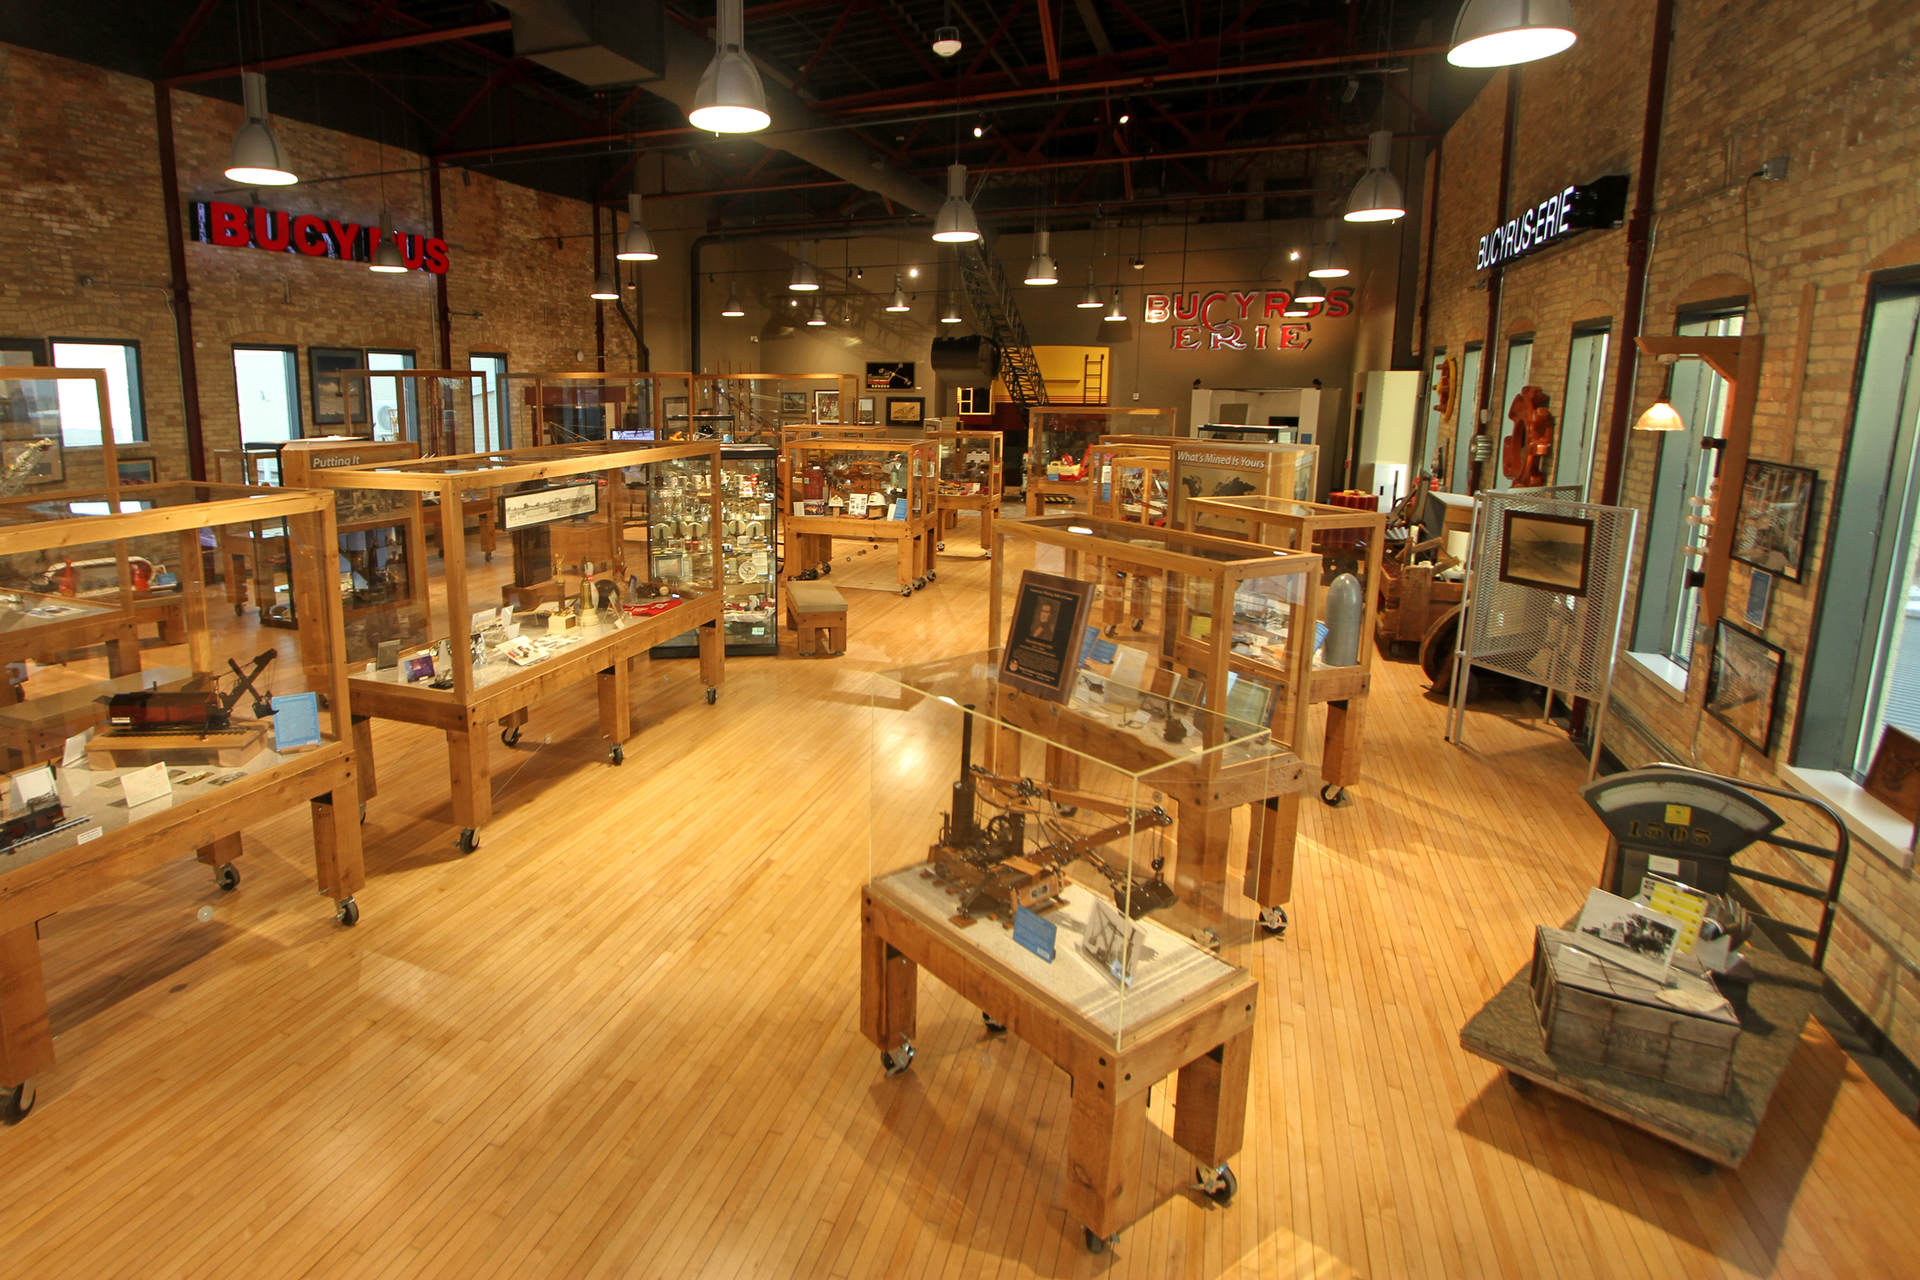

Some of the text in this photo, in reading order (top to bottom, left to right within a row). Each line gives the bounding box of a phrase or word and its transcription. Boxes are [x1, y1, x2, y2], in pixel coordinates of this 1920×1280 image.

[1476, 185, 1576, 271] BUCYRUS-ERIE
[1172, 321, 1312, 351] ERIE
[312, 455, 360, 468] Putting It
[1177, 451, 1265, 469] What's Mined Is Yours
[1628, 820, 1712, 846] 1505
